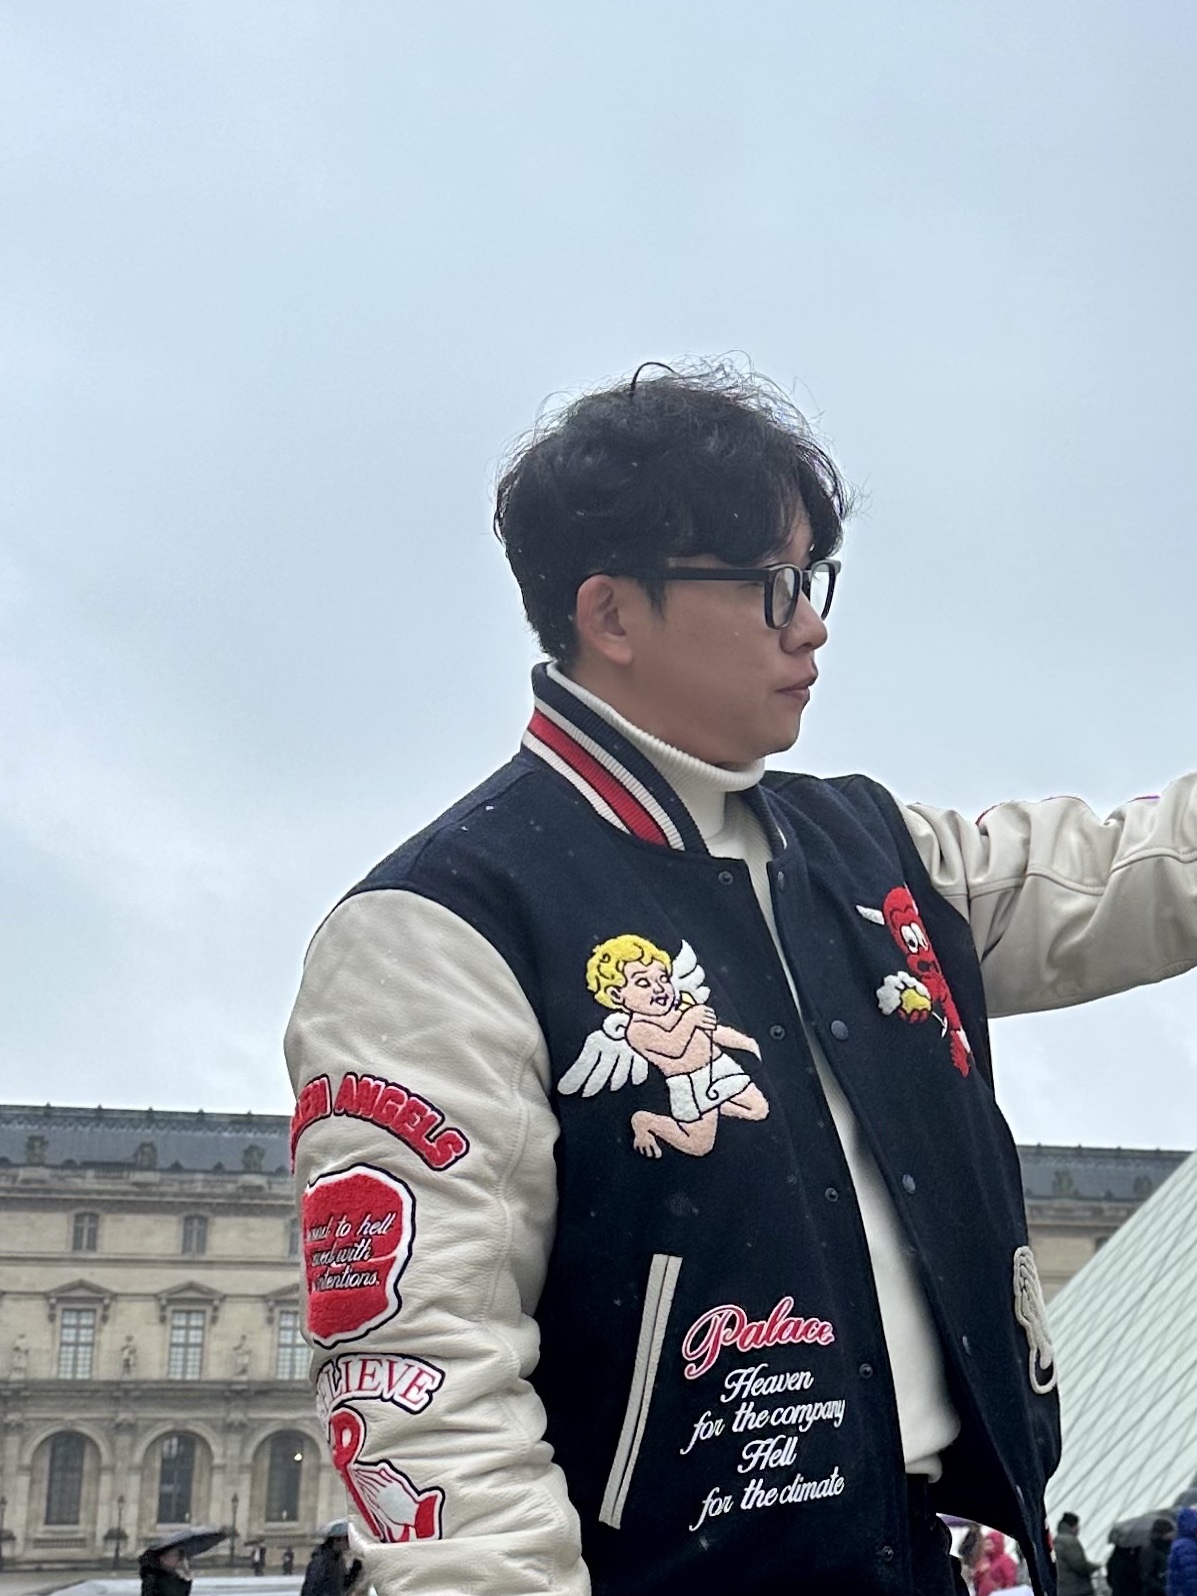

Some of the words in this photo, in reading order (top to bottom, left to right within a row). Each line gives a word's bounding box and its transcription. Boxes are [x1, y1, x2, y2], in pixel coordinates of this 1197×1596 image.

[335, 1072, 469, 1171] ANGELS
[335, 1214, 352, 1237] to
[357, 1212, 396, 1235] hell
[337, 1238, 372, 1262] with
[681, 1296, 835, 1380] Palace
[720, 1363, 814, 1402] Heaven
[680, 1410, 725, 1455] for
[732, 1401, 770, 1432] the
[770, 1400, 846, 1432] company
[737, 1434, 797, 1474] Hell
[689, 1486, 733, 1531] for
[740, 1478, 779, 1510] the
[779, 1466, 845, 1504] climate
